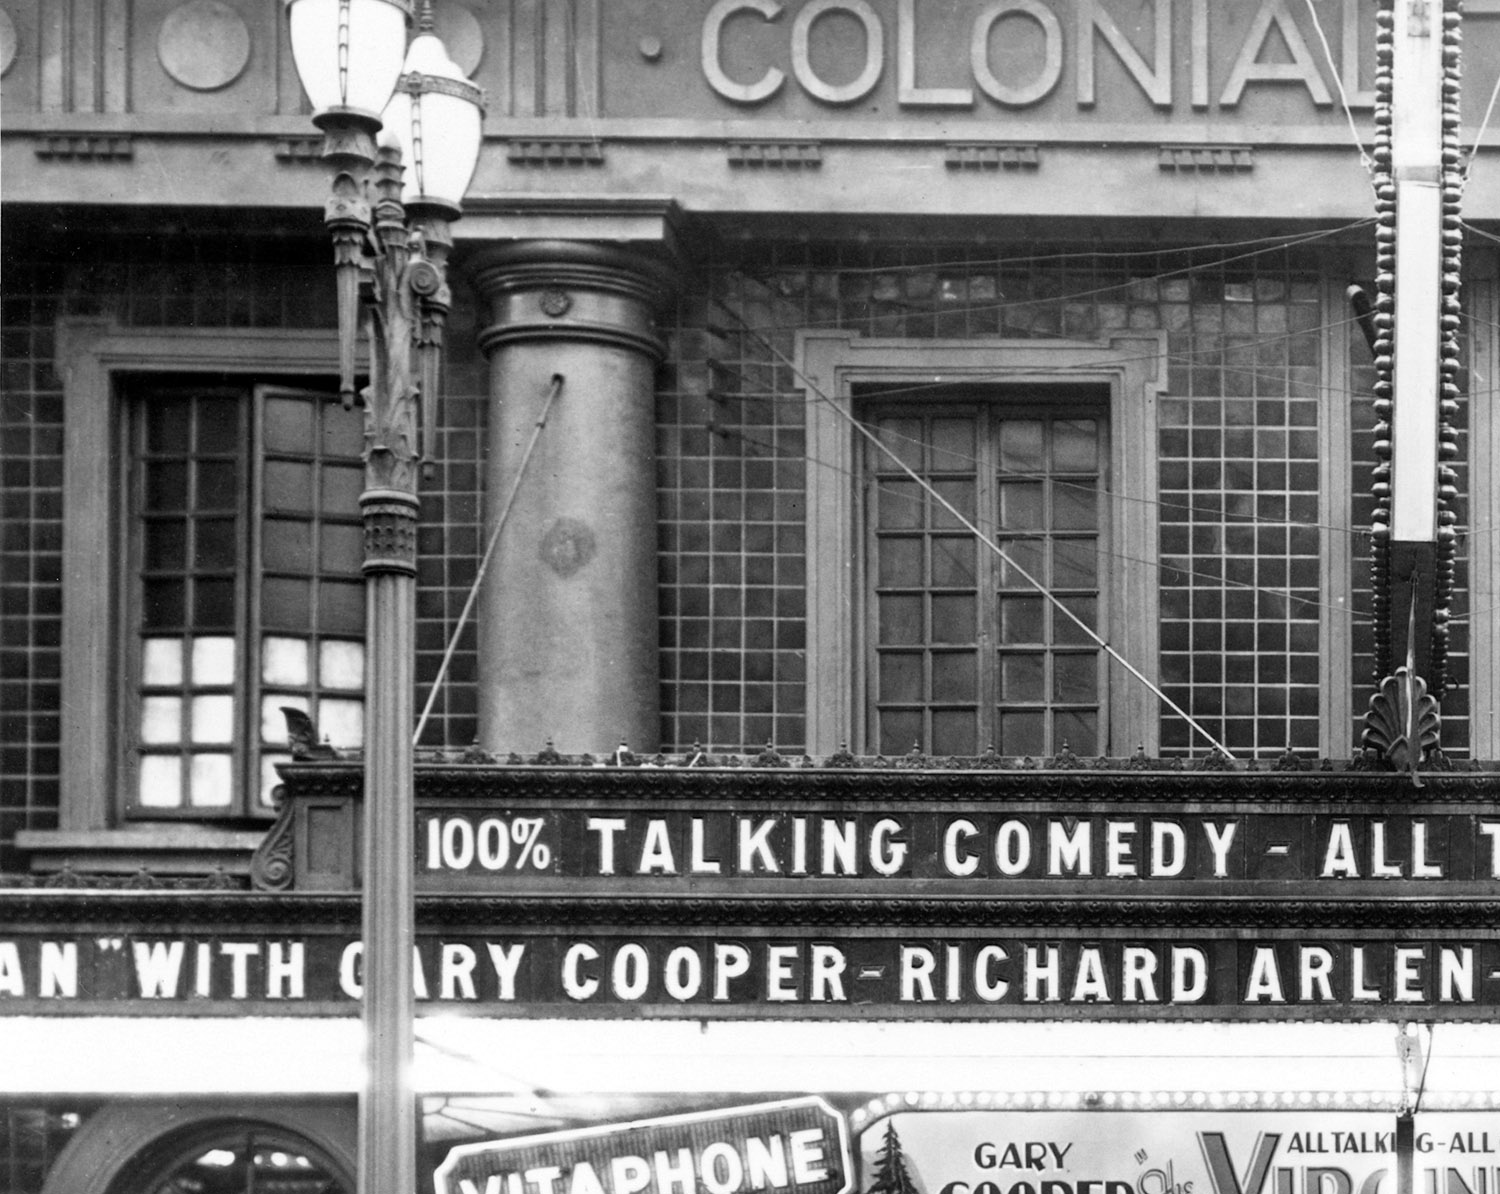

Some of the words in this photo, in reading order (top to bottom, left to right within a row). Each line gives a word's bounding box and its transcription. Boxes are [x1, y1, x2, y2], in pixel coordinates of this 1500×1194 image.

[427, 817, 551, 871] 100%
[587, 817, 908, 876] TALKING
[944, 818, 1238, 877] COMEDY
[1320, 822, 1444, 879] ALL
[973, 1142, 1074, 1171] GARY
